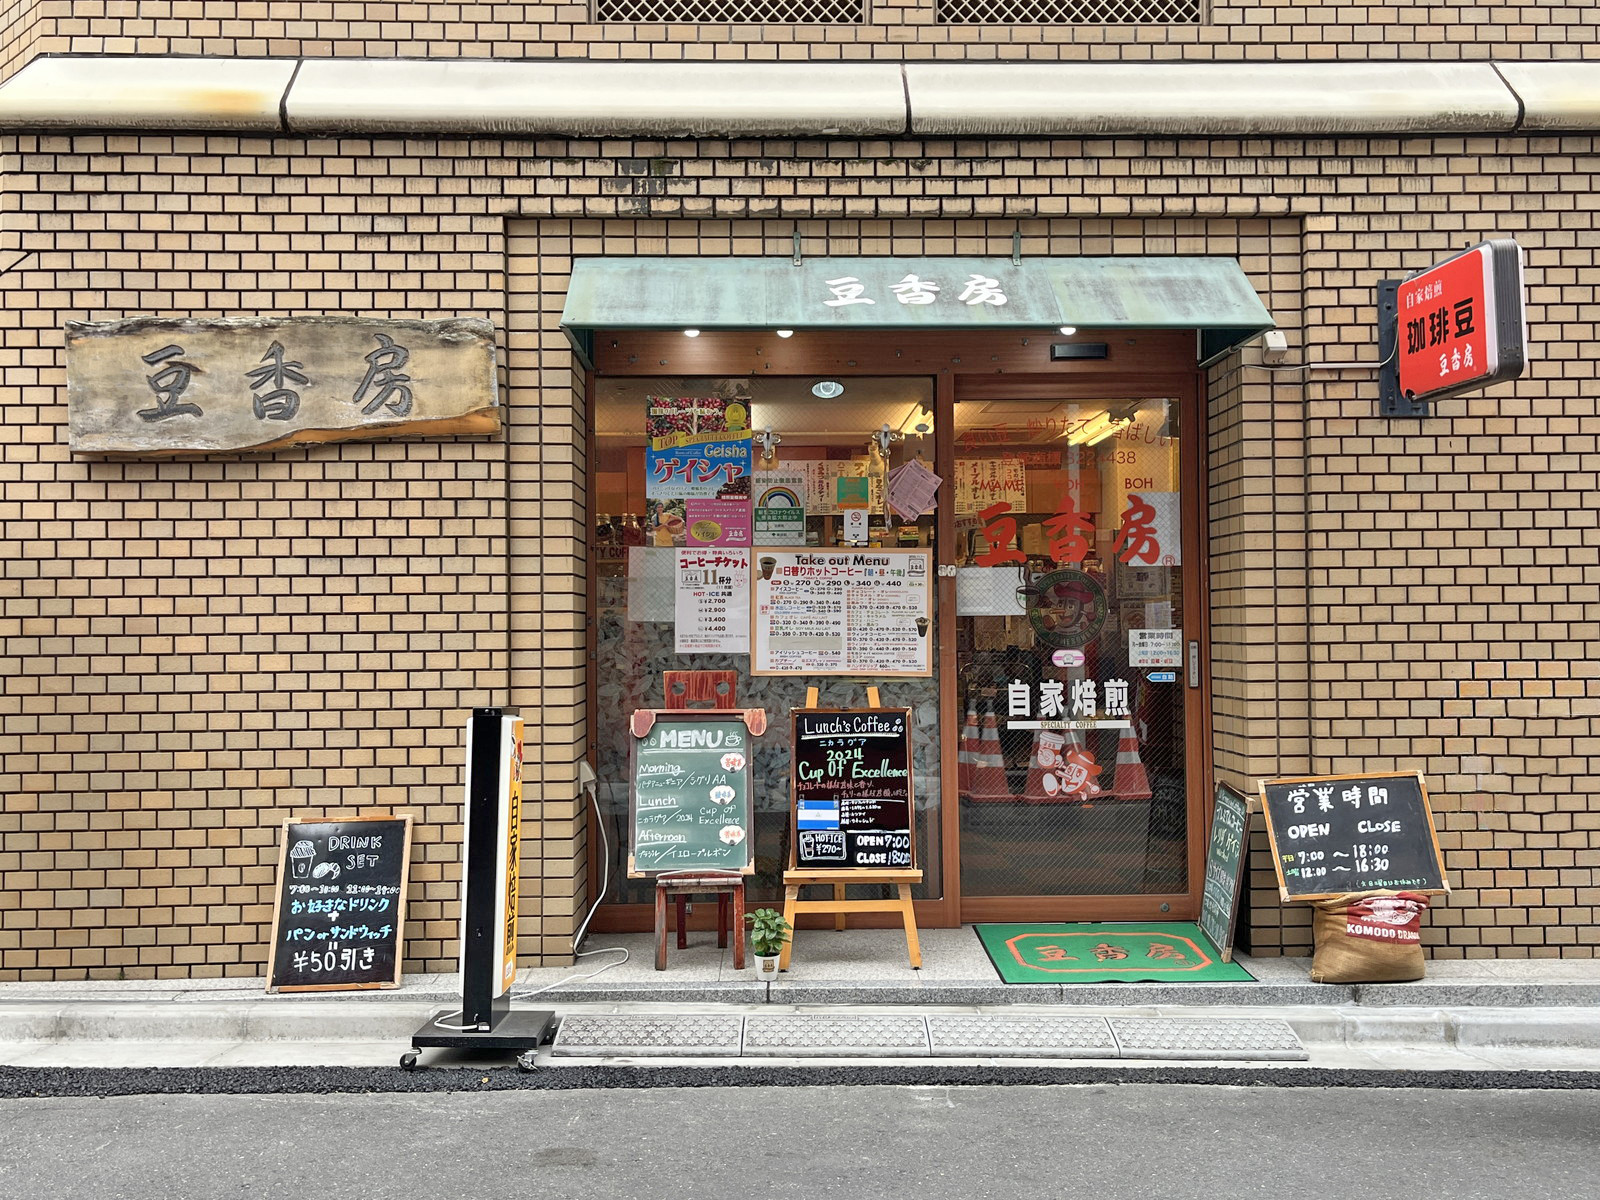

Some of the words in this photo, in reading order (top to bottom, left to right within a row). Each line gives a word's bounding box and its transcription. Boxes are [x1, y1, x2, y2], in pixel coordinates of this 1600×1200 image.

[823, 274, 1008, 307] 豆香房
[1406, 279, 1443, 309] 自家焙煎
[1407, 297, 1475, 355] 珈琲豆
[1439, 343, 1474, 377] 豆香房
[136, 333, 413, 423] 豆香房
[658, 436, 678, 449] TOP
[704, 445, 748, 458] Geisha
[653, 459, 744, 484] ゲイシャ
[980, 480, 1023, 492] MAME
[1124, 478, 1153, 489] BOH
[974, 494, 1160, 567] 豆香房
[680, 557, 748, 568] コーヒーチケット
[795, 554, 825, 566] Take
[829, 556, 849, 566] out
[852, 554, 890, 566] Menu
[784, 566, 862, 576] 日替りホットコーヒー
[1008, 679, 1130, 717] 自家焙煎
[804, 716, 851, 734] Lunch's
[853, 716, 890, 732] Coffee
[1040, 721, 1072, 729] SPECIALTY
[1075, 721, 1097, 729] COFFEE
[659, 729, 724, 748] MENU
[819, 738, 867, 747] ニカラグア
[826, 748, 864, 761] 2024
[639, 762, 681, 776] Morning
[799, 761, 824, 782] Cup
[852, 759, 908, 779] Excellence
[712, 774, 727, 785] AA
[638, 795, 677, 807] Lunch
[1287, 786, 1388, 814] 営業時間
[699, 807, 717, 815] Cup
[699, 813, 740, 825] Excellence
[638, 829, 687, 842] Afternoon
[1287, 823, 1330, 840] OPEN
[1358, 820, 1402, 834] CLOSE
[328, 836, 382, 851] DRINK
[857, 836, 884, 846] OPEN
[884, 835, 910, 848] 7:00
[346, 854, 380, 870] SET
[856, 852, 887, 864] CLOSE
[888, 850, 911, 865] 18:00
[1298, 851, 1325, 865] 7:00
[1352, 844, 1389, 859] 18:00
[1301, 866, 1327, 878] 12:00
[1355, 858, 1390, 873] 16:30
[291, 898, 390, 914] お好きなドリンク
[1346, 923, 1396, 939] KOMODO
[294, 947, 375, 973] ¥50引き
[1034, 943, 1186, 961] 豆香房
